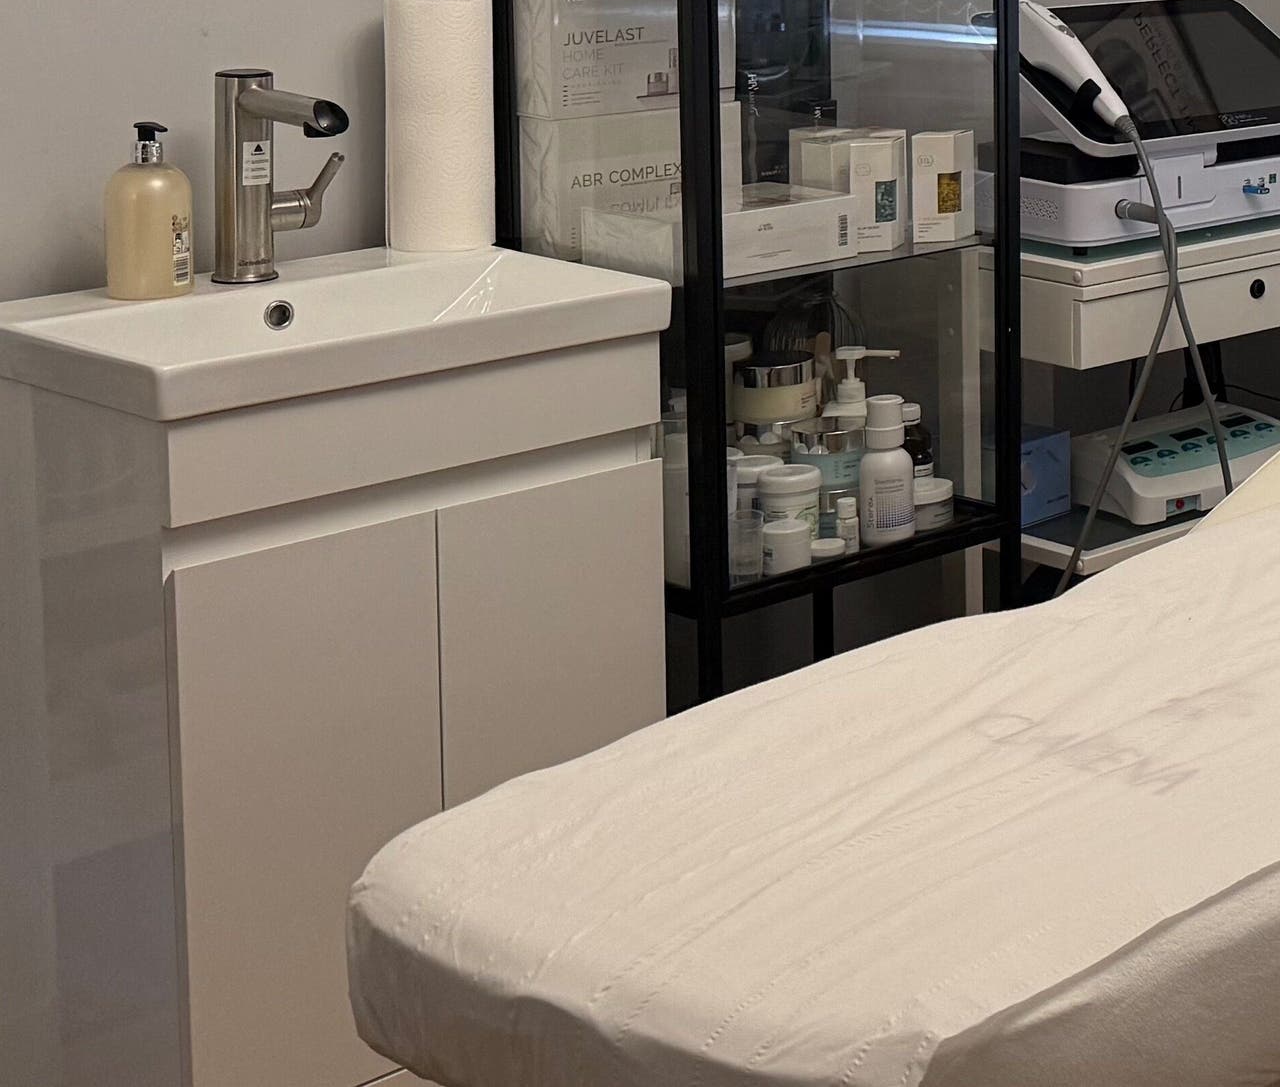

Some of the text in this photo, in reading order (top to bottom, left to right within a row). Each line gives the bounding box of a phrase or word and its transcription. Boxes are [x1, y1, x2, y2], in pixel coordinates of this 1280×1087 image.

[564, 26, 645, 47] JUVELAST
[563, 48, 605, 63] HOME
[562, 64, 599, 80] CARE
[571, 173, 603, 189] ABR
[609, 162, 682, 184] COMPLEX
